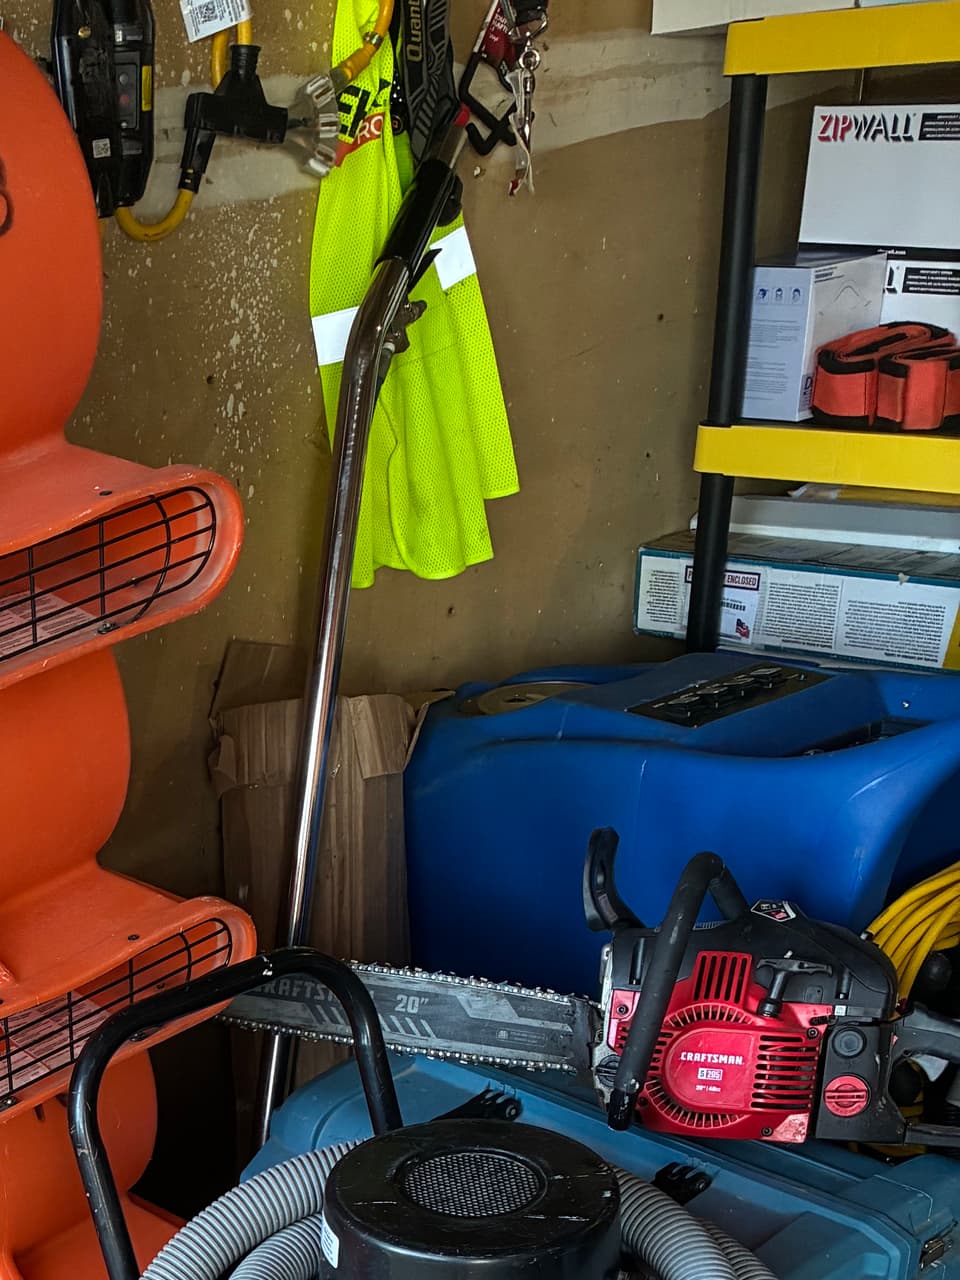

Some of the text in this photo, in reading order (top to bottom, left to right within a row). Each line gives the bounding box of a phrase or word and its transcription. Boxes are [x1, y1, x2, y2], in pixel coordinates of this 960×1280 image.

[817, 113, 914, 142] ZIPWALL
[727, 574, 757, 587] ENCLOSED
[680, 1051, 744, 1065] CRAFTSMAN
